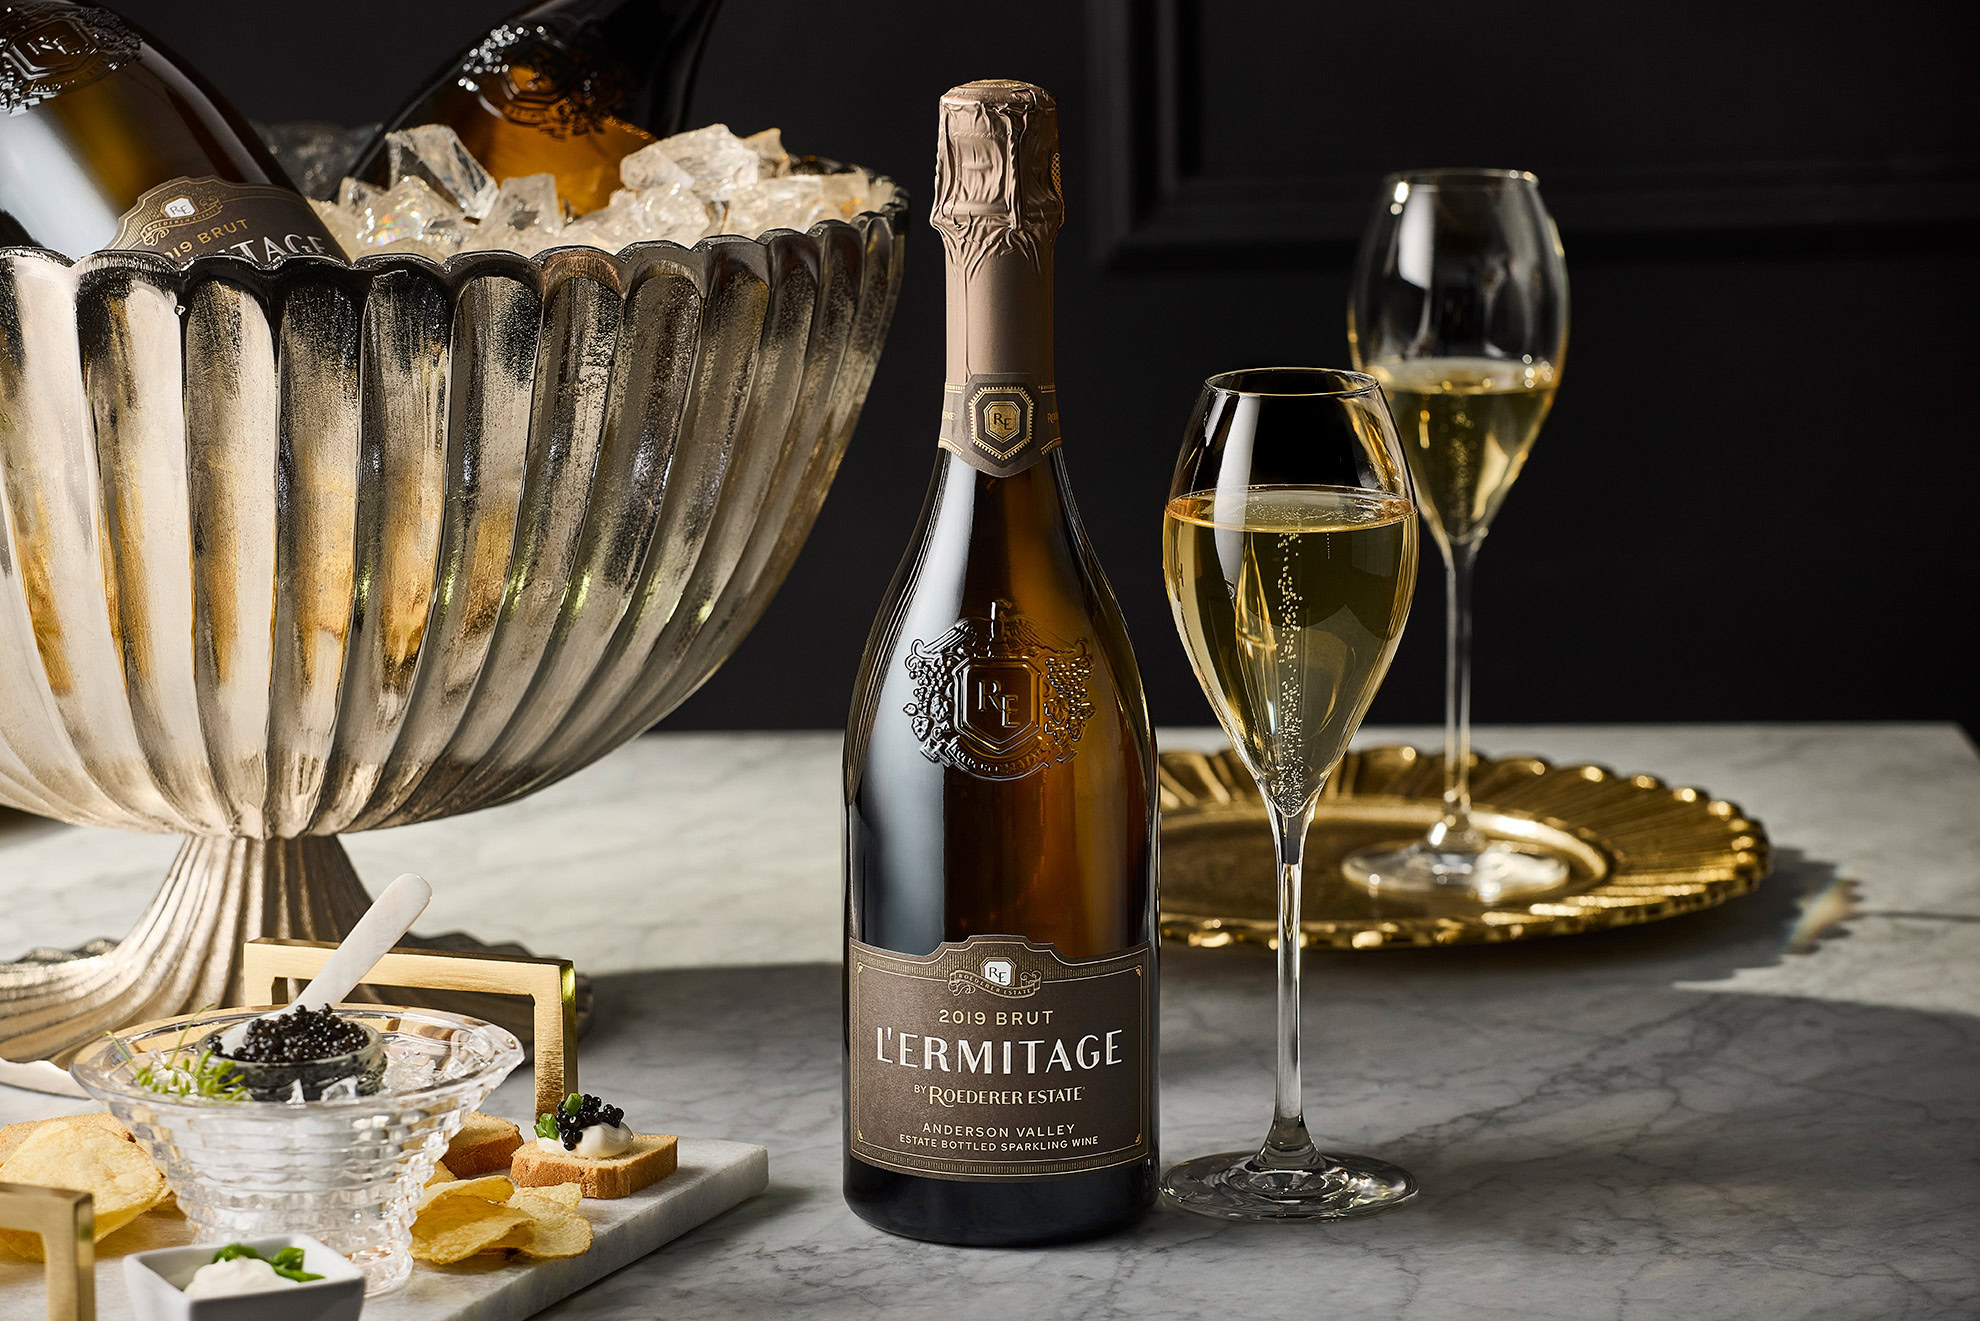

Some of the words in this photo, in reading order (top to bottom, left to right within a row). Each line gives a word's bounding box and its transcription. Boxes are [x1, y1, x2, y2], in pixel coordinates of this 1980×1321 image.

[169, 204, 192, 216] RE
[197, 218, 249, 244] BRUT
[993, 412, 1013, 431] RE
[978, 680, 1021, 729] RE
[958, 973, 1001, 993] ROEDERER
[1003, 988, 1032, 996] ESTATE
[988, 966, 1007, 984] RE
[938, 1009, 987, 1025] 2019
[996, 1010, 1054, 1026] BRUT
[876, 1026, 1123, 1075] L'ERMITAGE
[914, 1084, 927, 1094] BY
[929, 1085, 1024, 1108] ROEDERER
[1028, 1086, 1083, 1105] ESTATE
[922, 1122, 1010, 1138] ANDERSON
[1016, 1123, 1076, 1138] VALLEY
[899, 1133, 938, 1148] ESTATE
[941, 1140, 997, 1151] BOTTLED
[1000, 1138, 1069, 1152] SPARKLING
[1071, 1135, 1099, 1148] WINE
